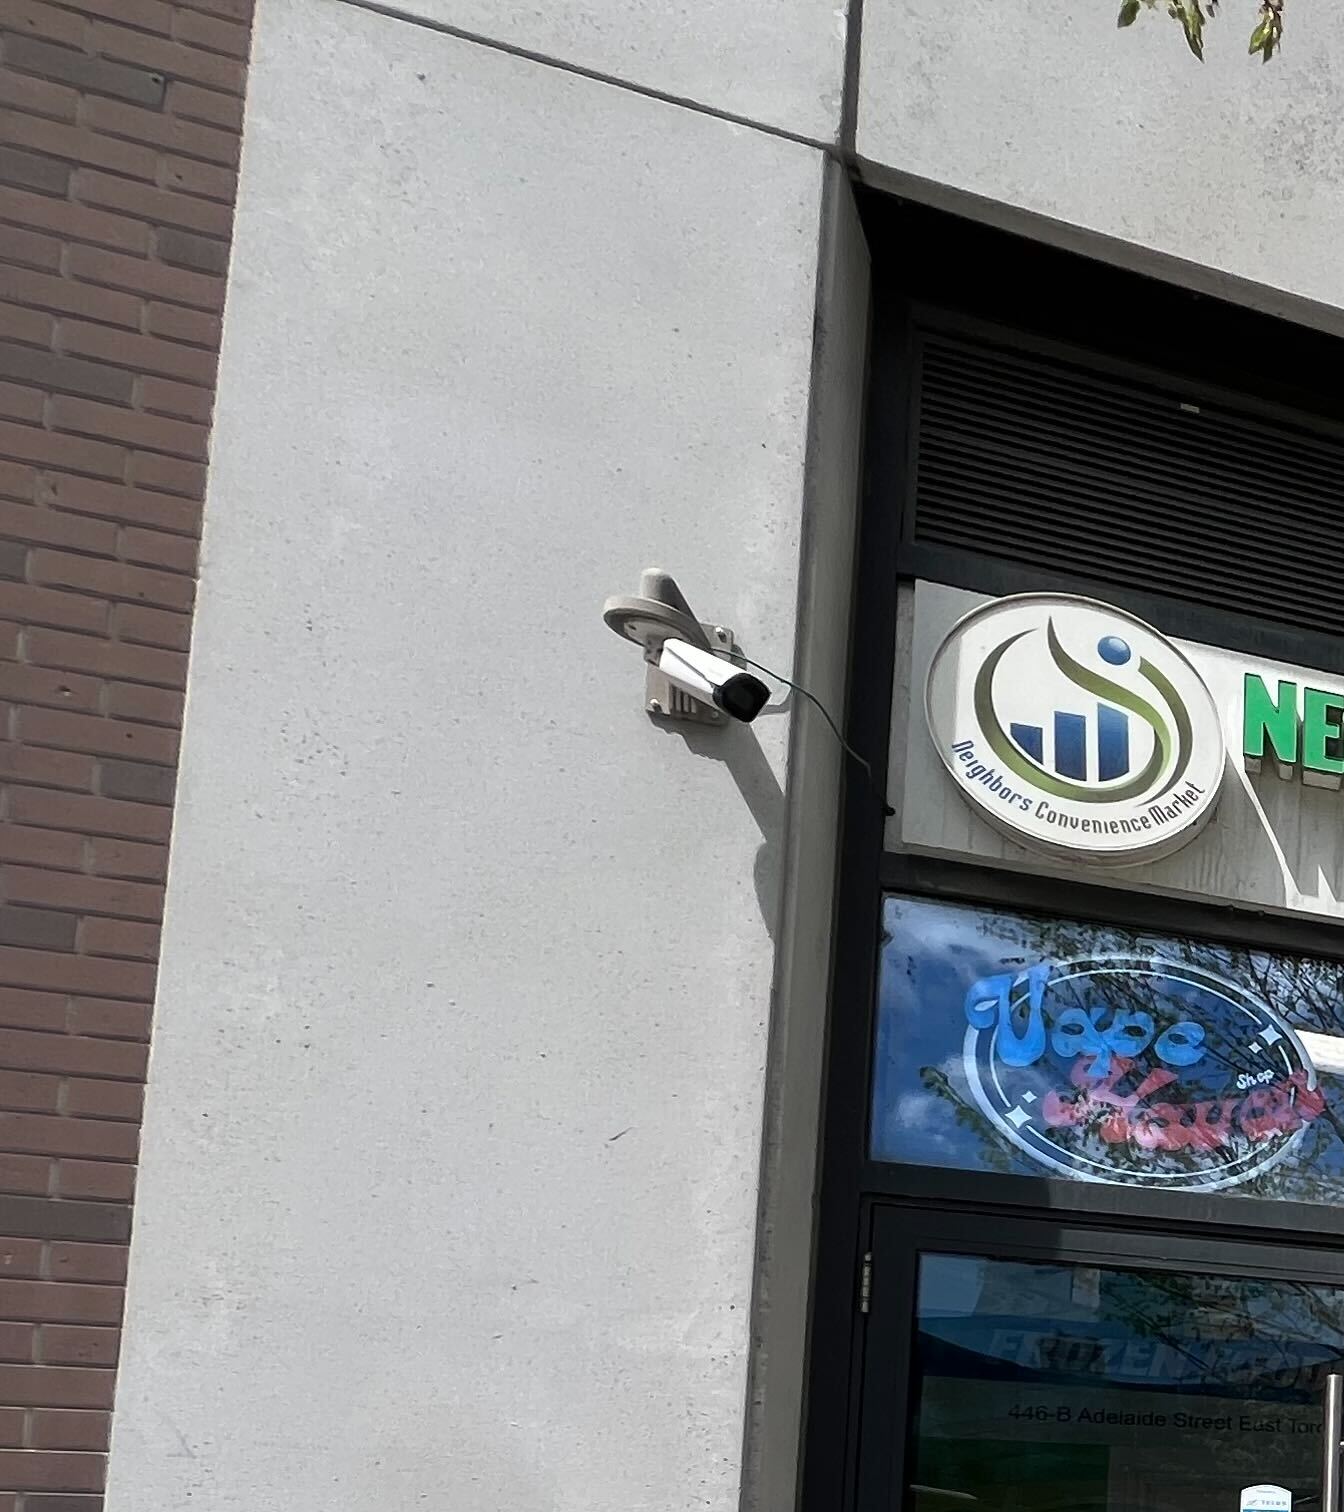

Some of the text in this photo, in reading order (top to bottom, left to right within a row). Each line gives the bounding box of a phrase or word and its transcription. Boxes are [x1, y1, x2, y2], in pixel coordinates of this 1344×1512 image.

[952, 740, 1206, 834] Neighbors Convenience Market
[965, 963, 1206, 1078] Vape
[1008, 1405, 1281, 1433] 446-B Adelaide Street East
